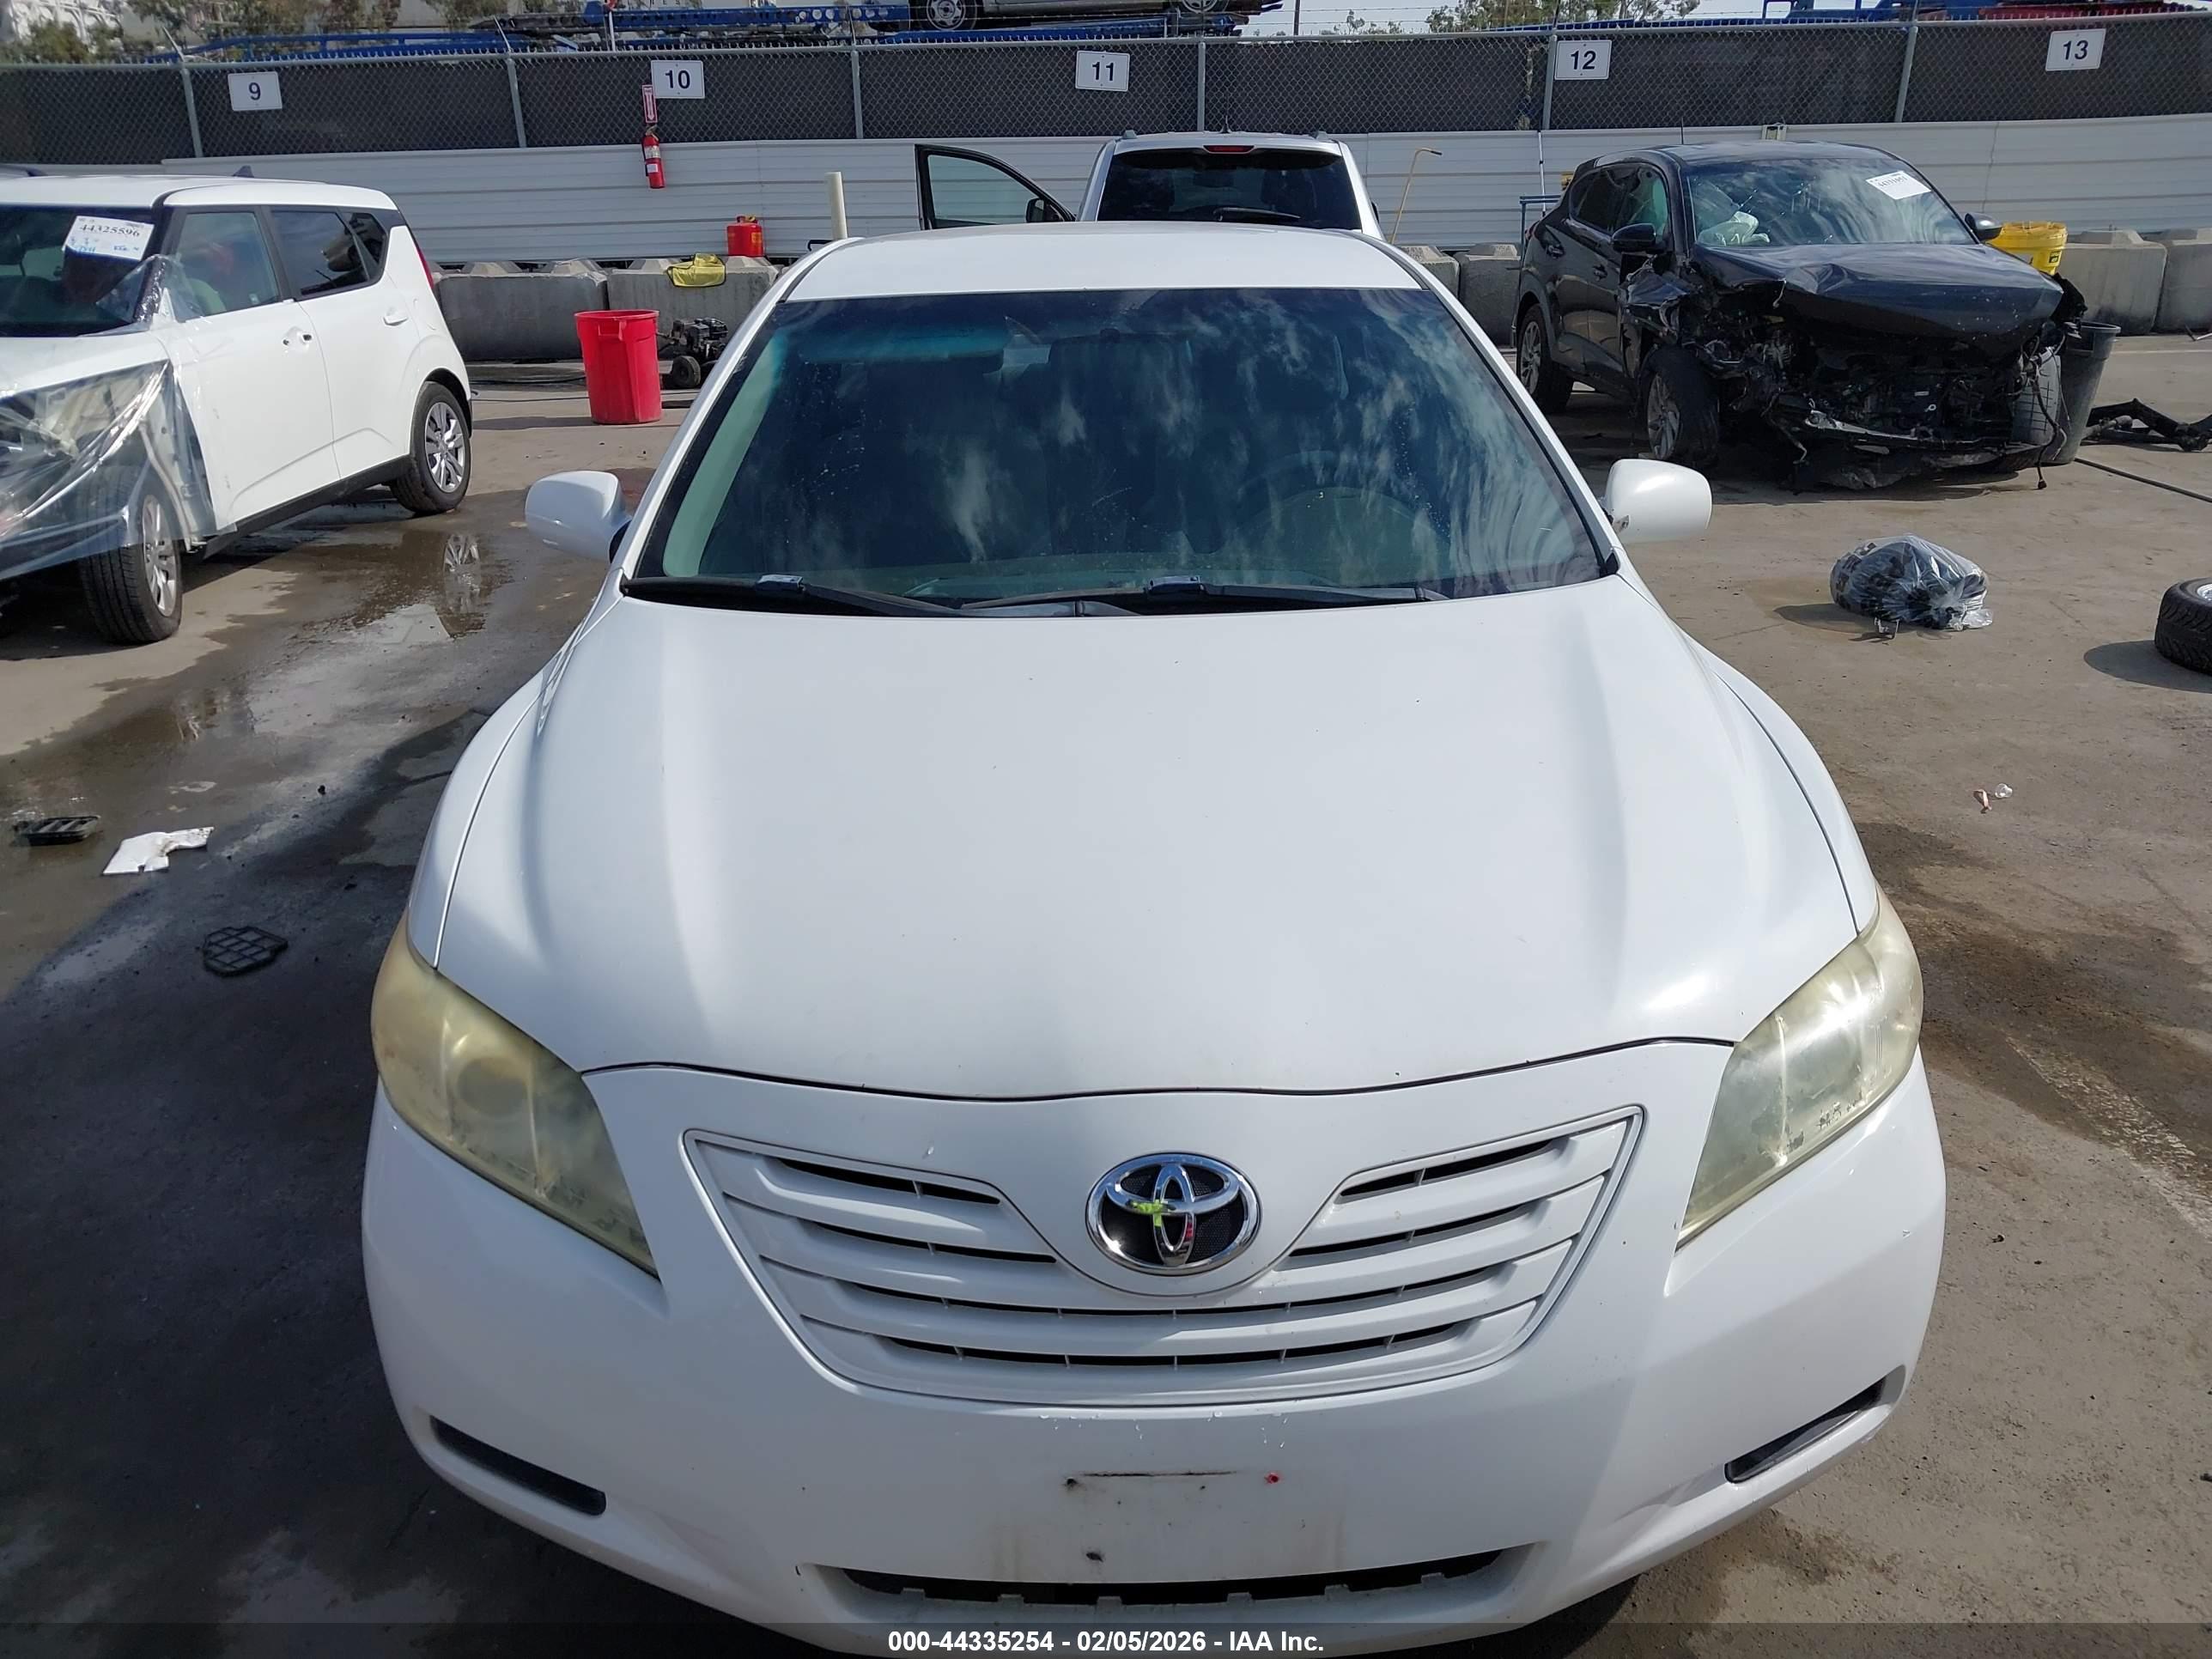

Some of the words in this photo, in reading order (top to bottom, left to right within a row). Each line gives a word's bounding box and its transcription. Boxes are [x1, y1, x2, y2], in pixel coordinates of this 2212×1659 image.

[2063, 40, 2088, 60] 13
[1571, 50, 1595, 70] 12
[665, 70, 690, 88] 10
[1092, 62, 1115, 81] 11
[248, 82, 261, 101] 9
